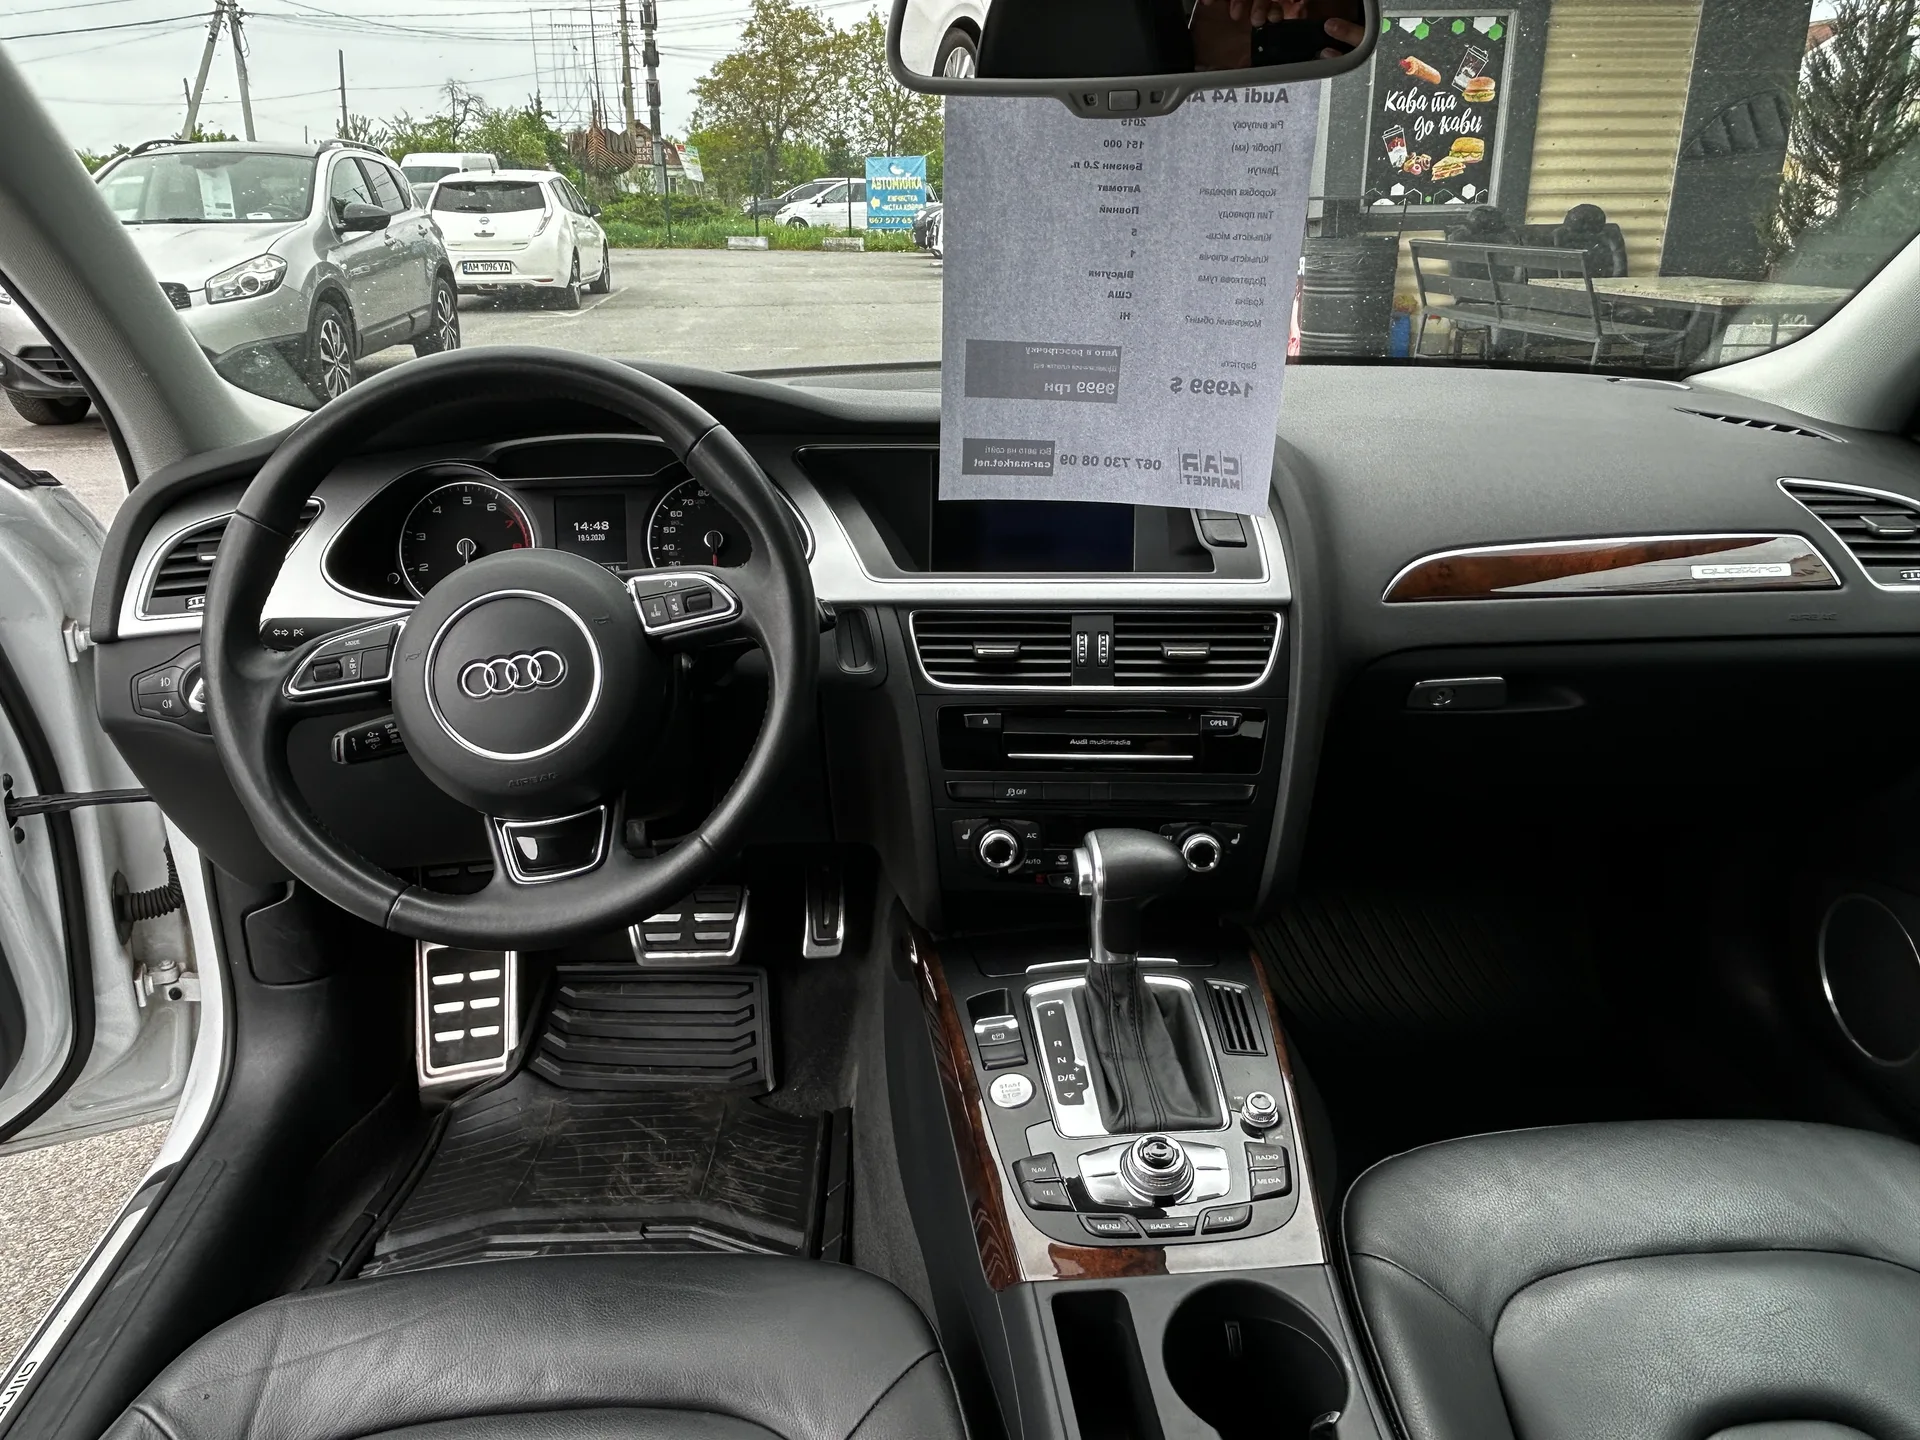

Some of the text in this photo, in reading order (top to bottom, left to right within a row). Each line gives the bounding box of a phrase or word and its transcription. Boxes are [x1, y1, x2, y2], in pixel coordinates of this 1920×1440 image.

[1384, 86, 1457, 114] Кава та
[1413, 107, 1482, 141] до кави
[462, 496, 472, 505] 5
[432, 505, 442, 514] 4
[486, 502, 497, 511] 6
[505, 520, 514, 529] 7
[573, 520, 610, 531] 14:48
[416, 532, 426, 541] 3
[662, 543, 675, 551] 40
[418, 563, 429, 572] 2
[1701, 565, 1782, 575] quattro
[1209, 719, 1228, 727] OPEN
[1070, 738, 1088, 746] Audi
[1057, 1056, 1067, 1064] N
[1255, 1153, 1279, 1161] RADIO
[1031, 1166, 1047, 1174] NAV
[1097, 1222, 1121, 1230] MENU
[1149, 1222, 1171, 1230] BACK
